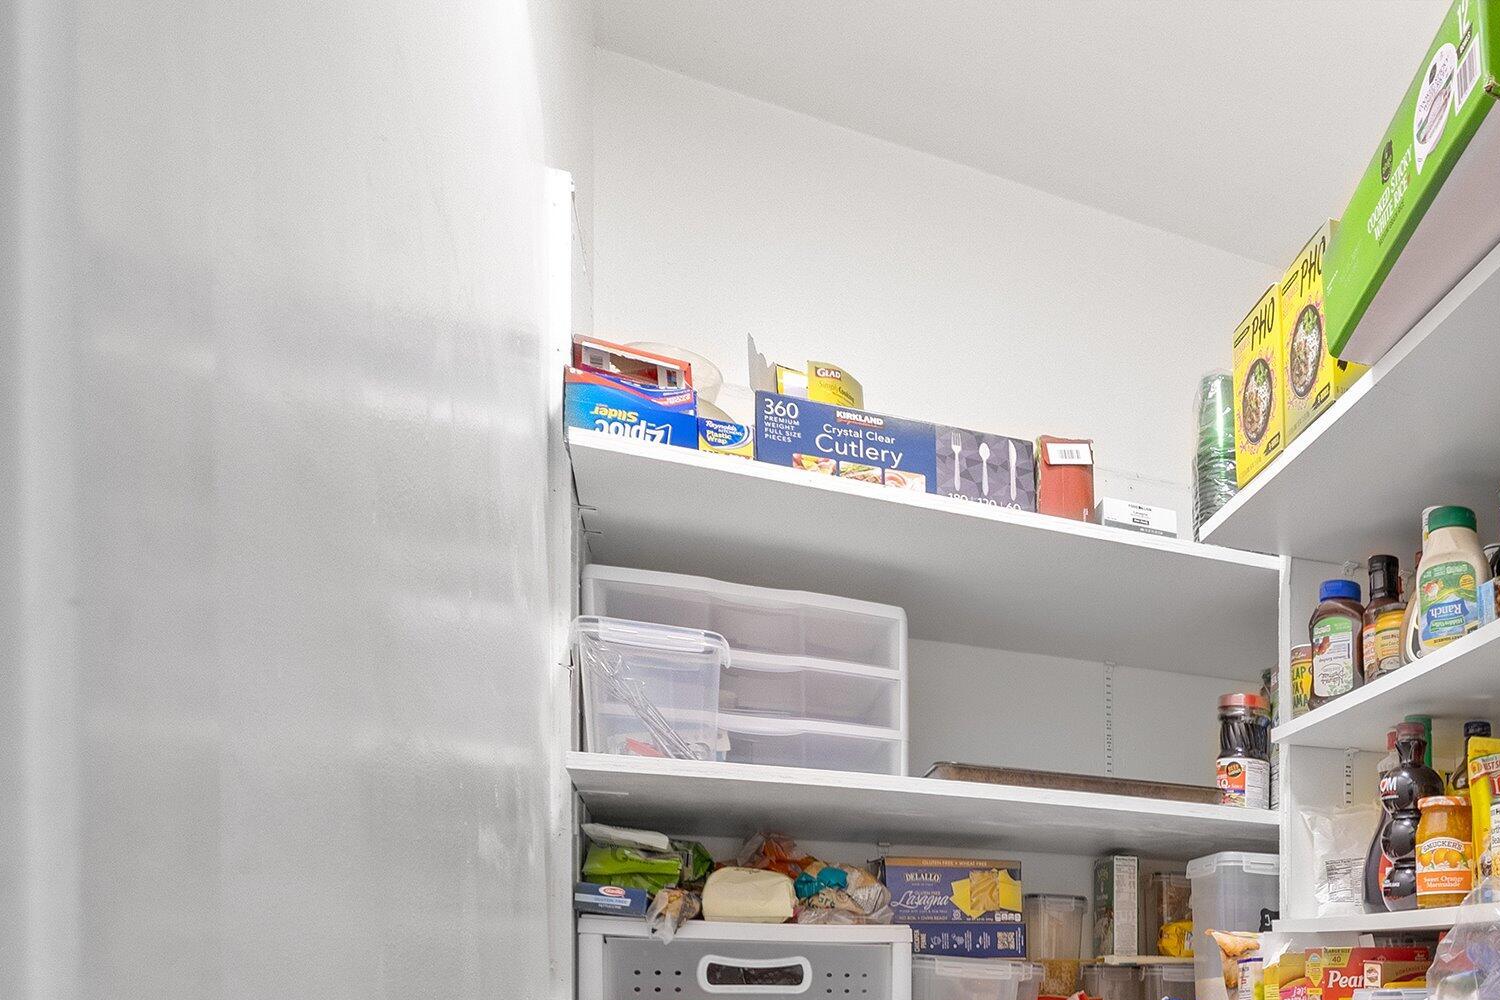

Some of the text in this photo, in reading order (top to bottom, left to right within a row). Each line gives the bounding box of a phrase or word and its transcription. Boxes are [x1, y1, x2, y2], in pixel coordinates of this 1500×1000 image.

[1251, 297, 1275, 351] PHO
[816, 368, 841, 380] GLAD
[763, 398, 799, 420] 360
[764, 415, 800, 427] PREMIUM
[835, 410, 884, 427] KIRKLAND
[764, 421, 795, 432] WEIGHT
[764, 427, 802, 440] FULL SIZE
[764, 433, 792, 444] PIECES
[823, 423, 863, 440] Crystal
[866, 431, 896, 445] Clear
[815, 433, 903, 469] Cutlery
[1431, 603, 1462, 618] Ranch
[1422, 839, 1465, 853] SMUCKER'S
[904, 872, 941, 882] DELALLO
[1440, 875, 1465, 884] Orange
[890, 890, 950, 911] Lasagna
[1328, 970, 1364, 988] Pear
